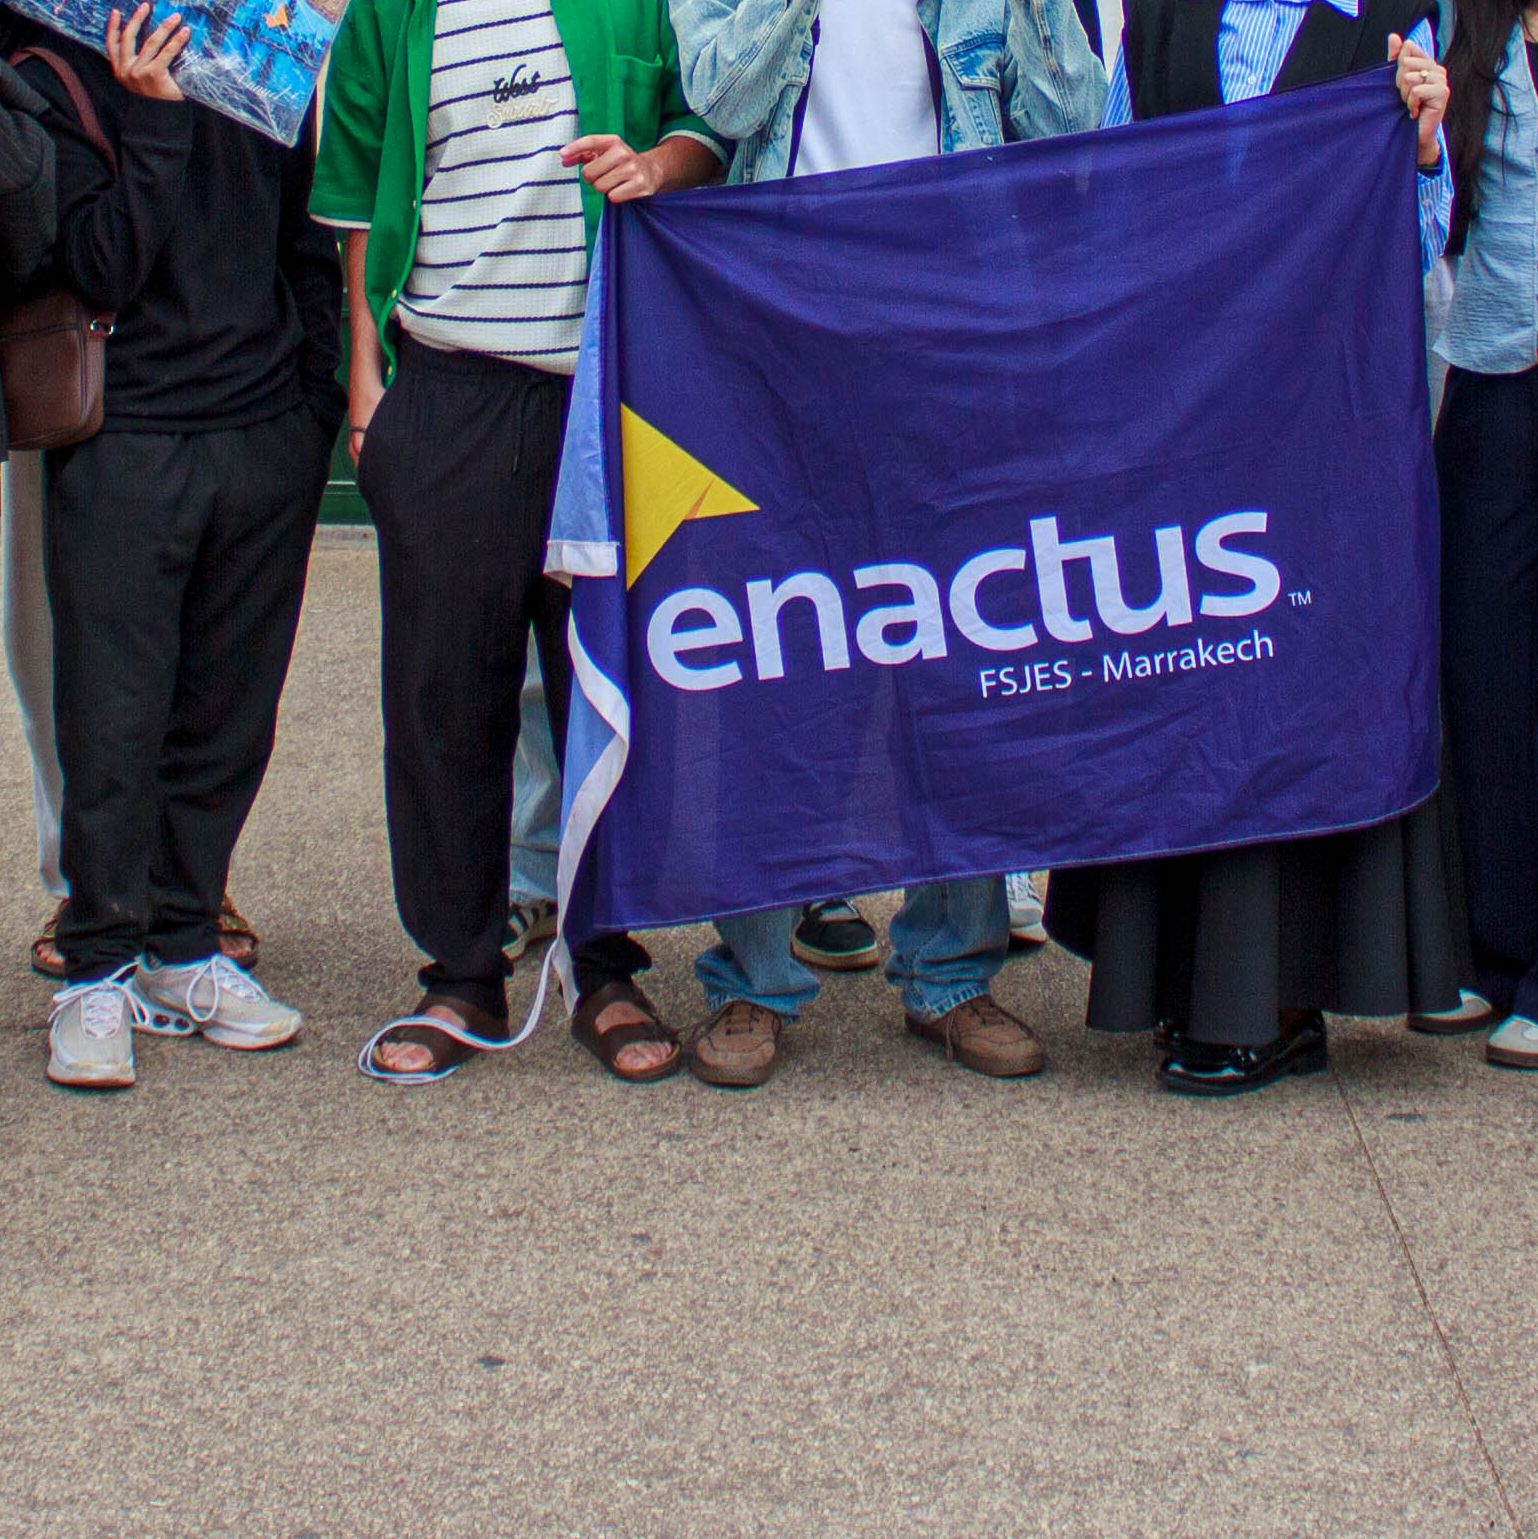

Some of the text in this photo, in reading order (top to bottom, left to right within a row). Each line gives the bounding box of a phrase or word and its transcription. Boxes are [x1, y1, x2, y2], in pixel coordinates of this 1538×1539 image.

[646, 511, 1281, 692] enactus
[979, 660, 1073, 699] FSJES
[1101, 629, 1275, 683] Marrakech
